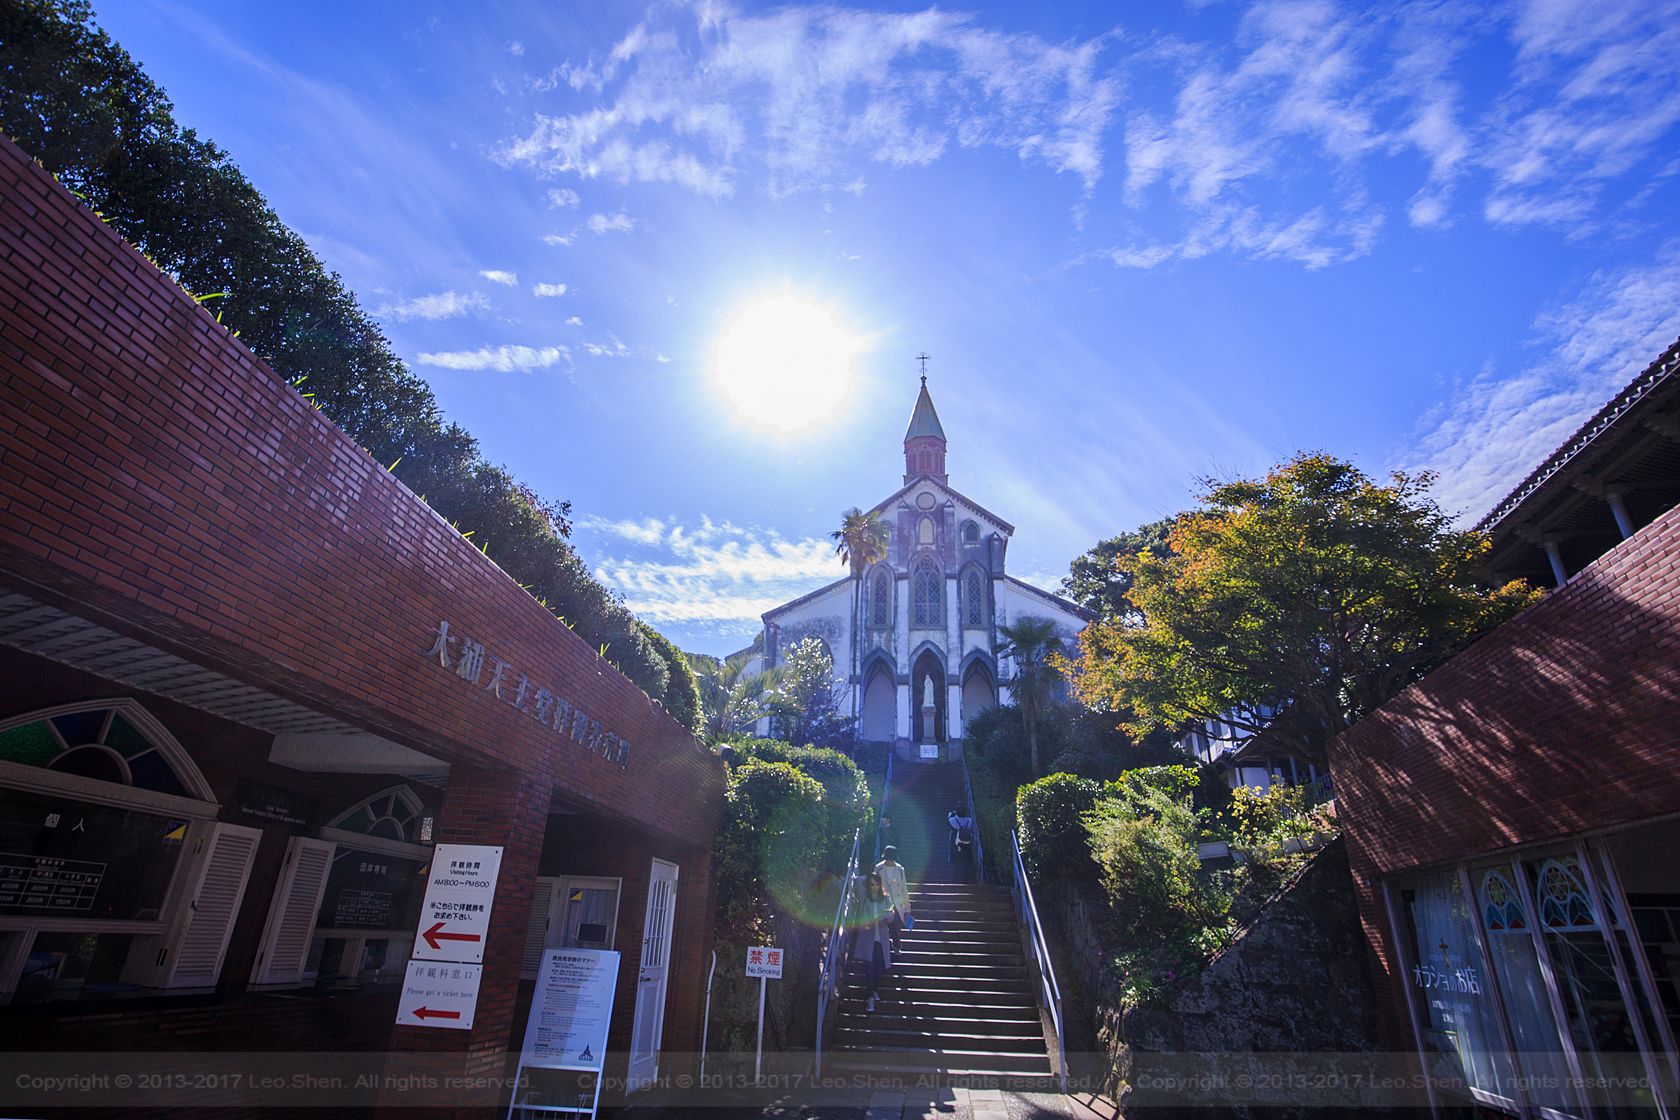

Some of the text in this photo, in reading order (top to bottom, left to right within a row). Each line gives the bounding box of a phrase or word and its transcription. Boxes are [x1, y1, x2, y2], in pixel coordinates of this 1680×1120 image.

[749, 950, 780, 966] 禁煙
[757, 967, 780, 976] Smoking
[1412, 964, 1480, 995] オラショのお店
[406, 987, 424, 995] Please
[426, 989, 435, 997] get
